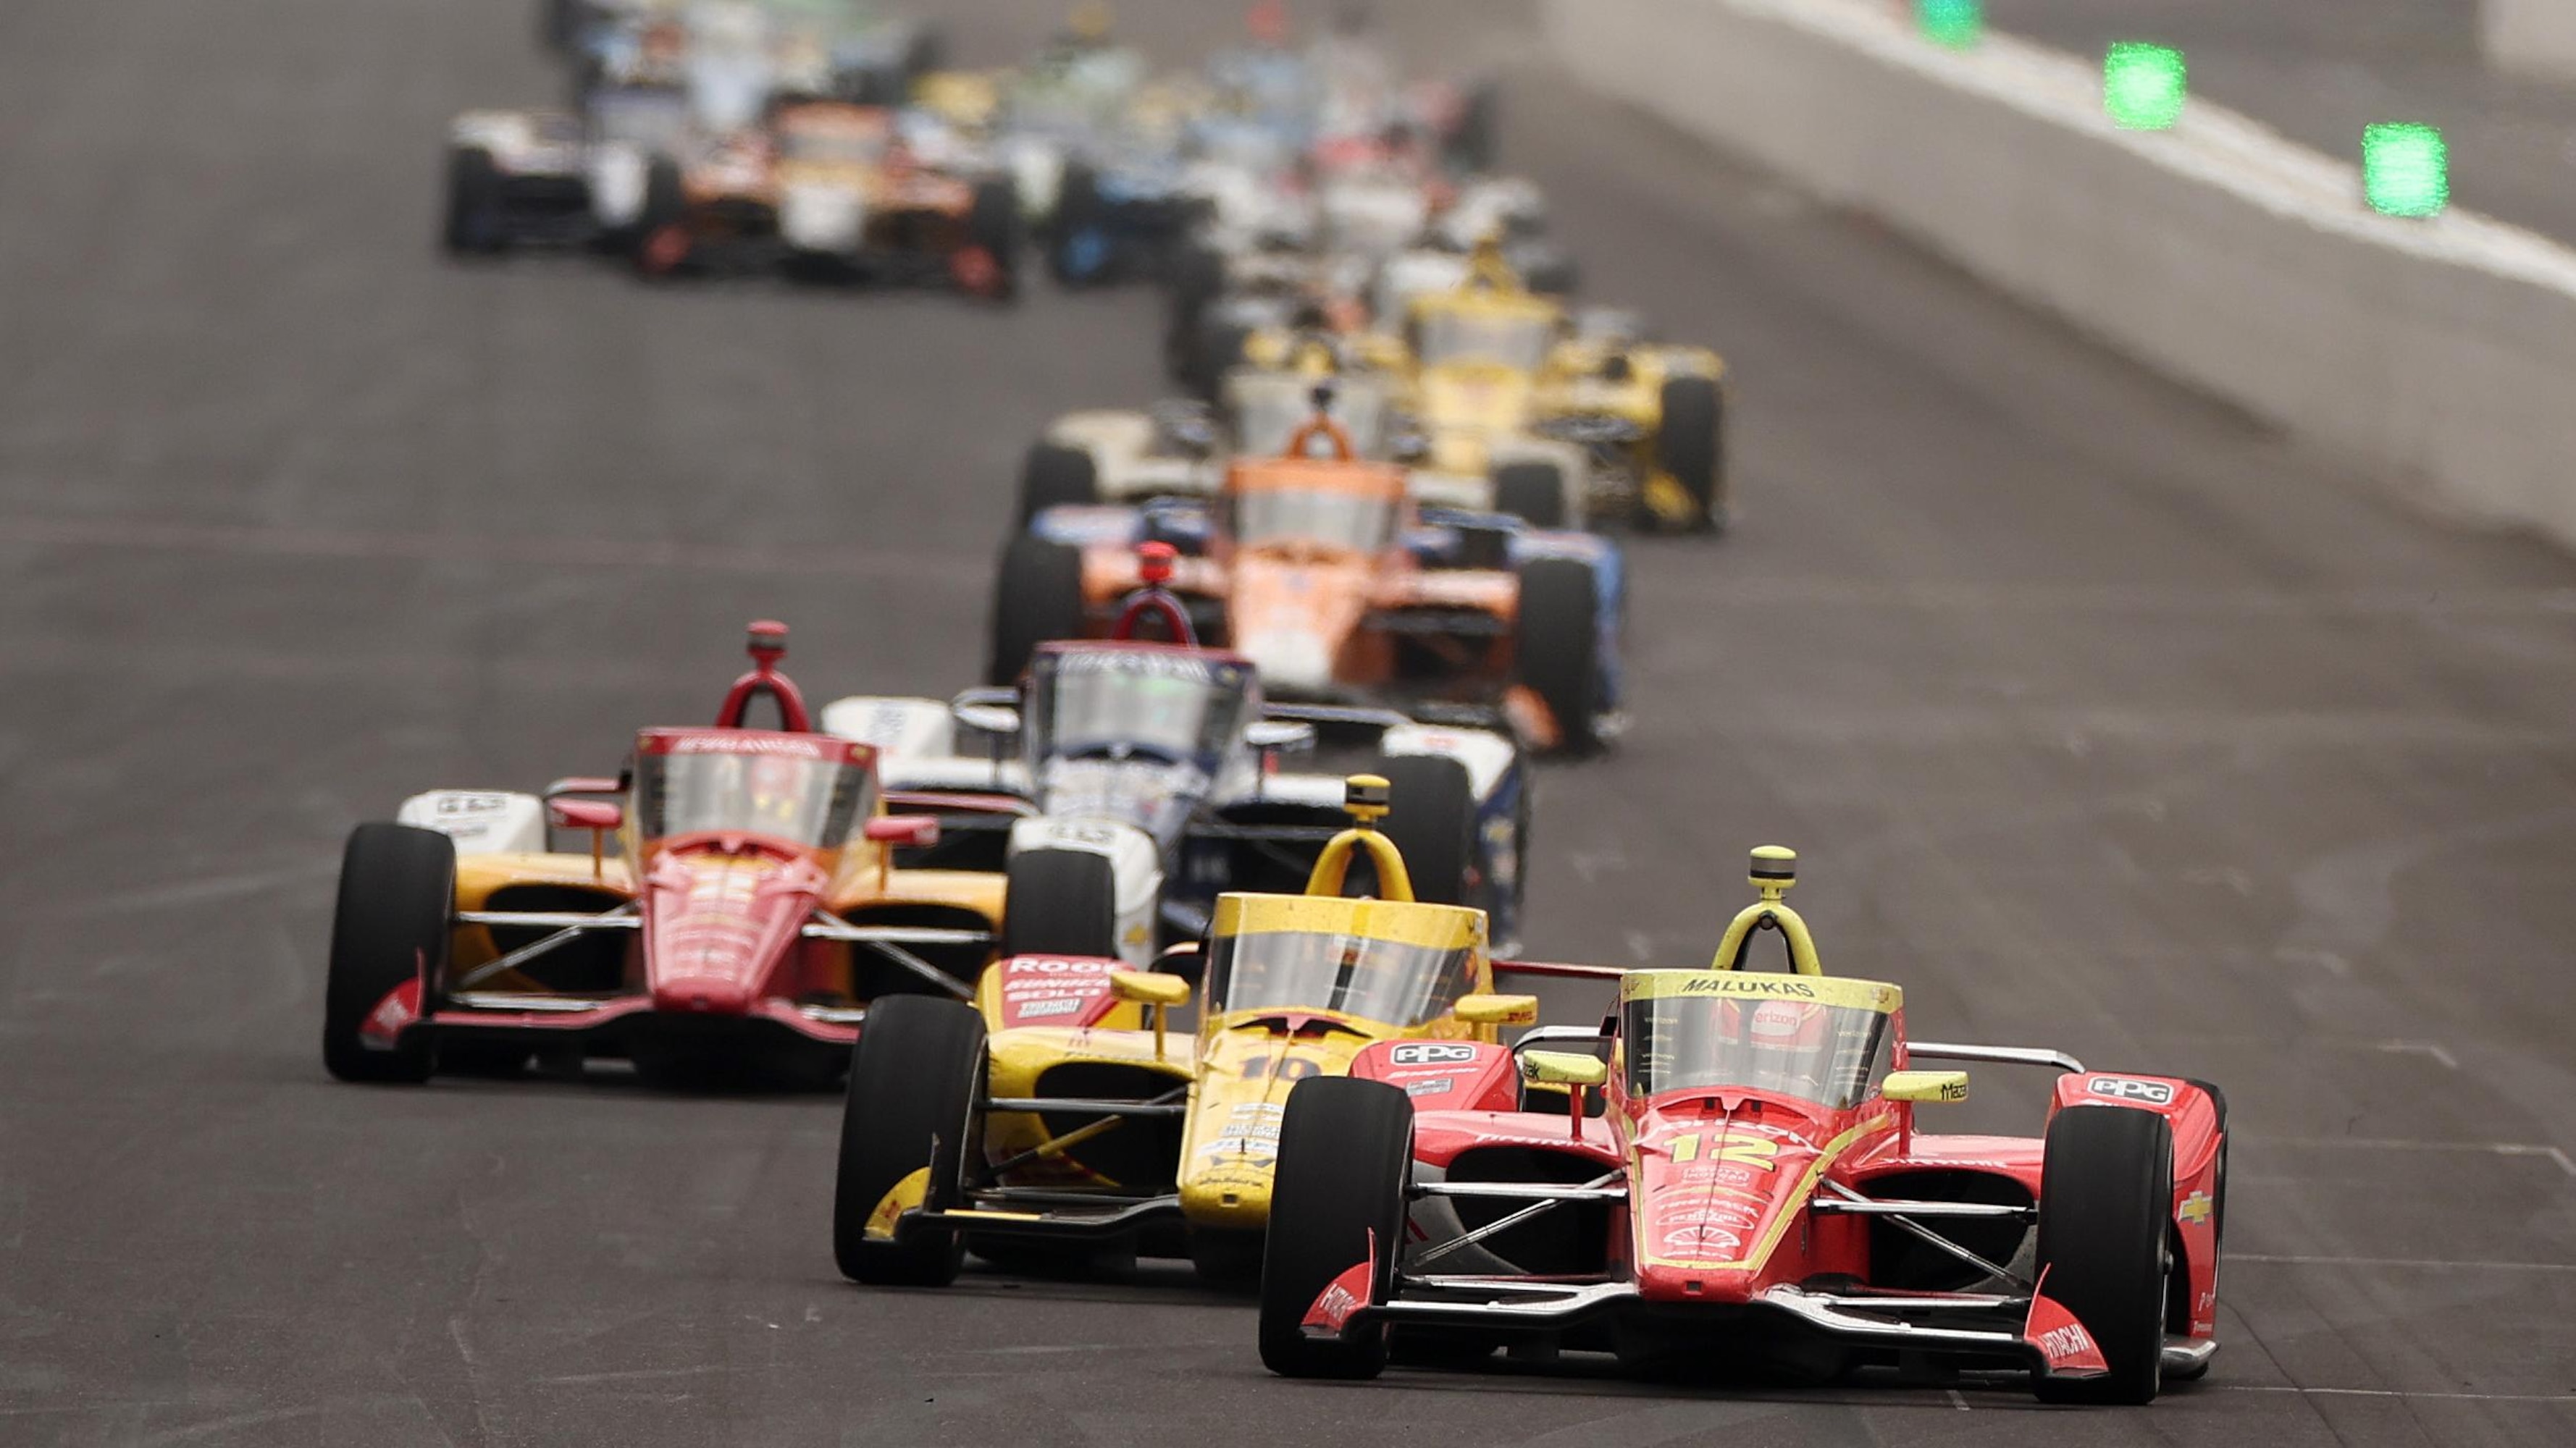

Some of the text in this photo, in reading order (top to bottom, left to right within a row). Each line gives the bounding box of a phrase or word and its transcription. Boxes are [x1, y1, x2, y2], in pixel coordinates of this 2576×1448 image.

[1682, 979, 1816, 998] MALUKAS
[1396, 1045, 1472, 1063] PPG
[1238, 1056, 1322, 1082] 10
[2093, 1079, 2168, 1101] PPG
[1663, 1132, 1780, 1173] 12
